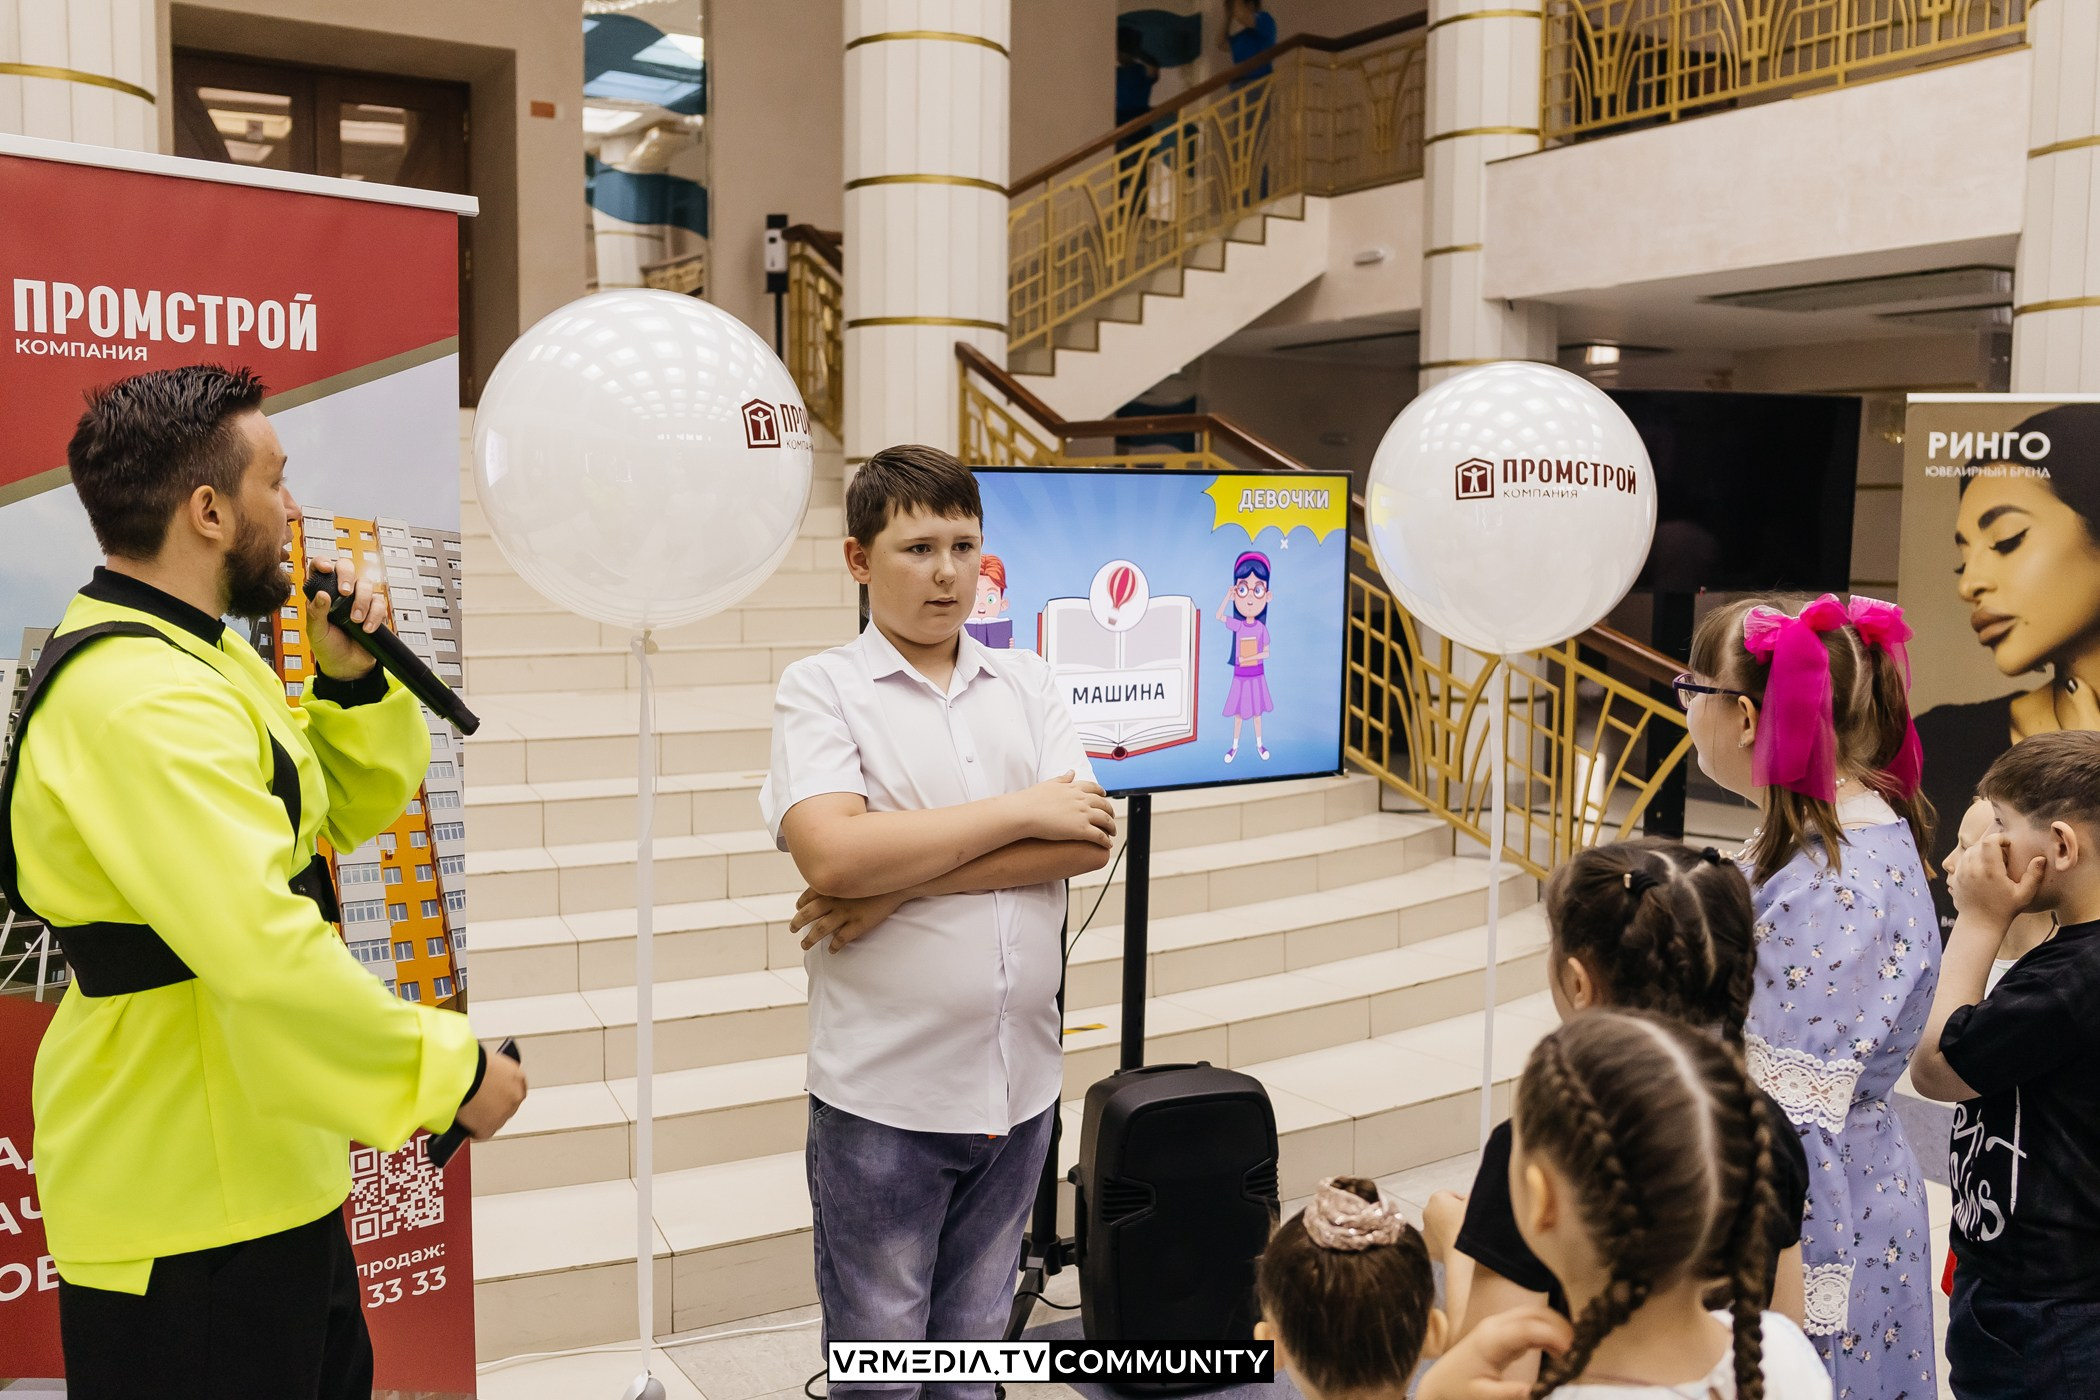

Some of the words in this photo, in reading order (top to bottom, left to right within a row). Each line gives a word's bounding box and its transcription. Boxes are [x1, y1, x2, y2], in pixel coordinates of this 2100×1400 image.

[13, 278, 318, 352] ПРОМСТРОЙ
[15, 338, 148, 361] КОМПАНИЯ
[1928, 431, 2051, 461] РИНГО
[1502, 458, 1637, 495] ПРОМСТРОЙ
[1925, 464, 2007, 478] ЮВЕЛИРНЫЙ
[2010, 466, 2051, 479] БРЕНД
[1238, 489, 1330, 513] ДЕВОЧКИ
[1503, 488, 1579, 499] КОМПАНИЯ
[1072, 682, 1165, 705] МАШИНА
[356, 1242, 446, 1279] продаж:
[366, 1277, 403, 1308] 33
[411, 1265, 447, 1296] 33
